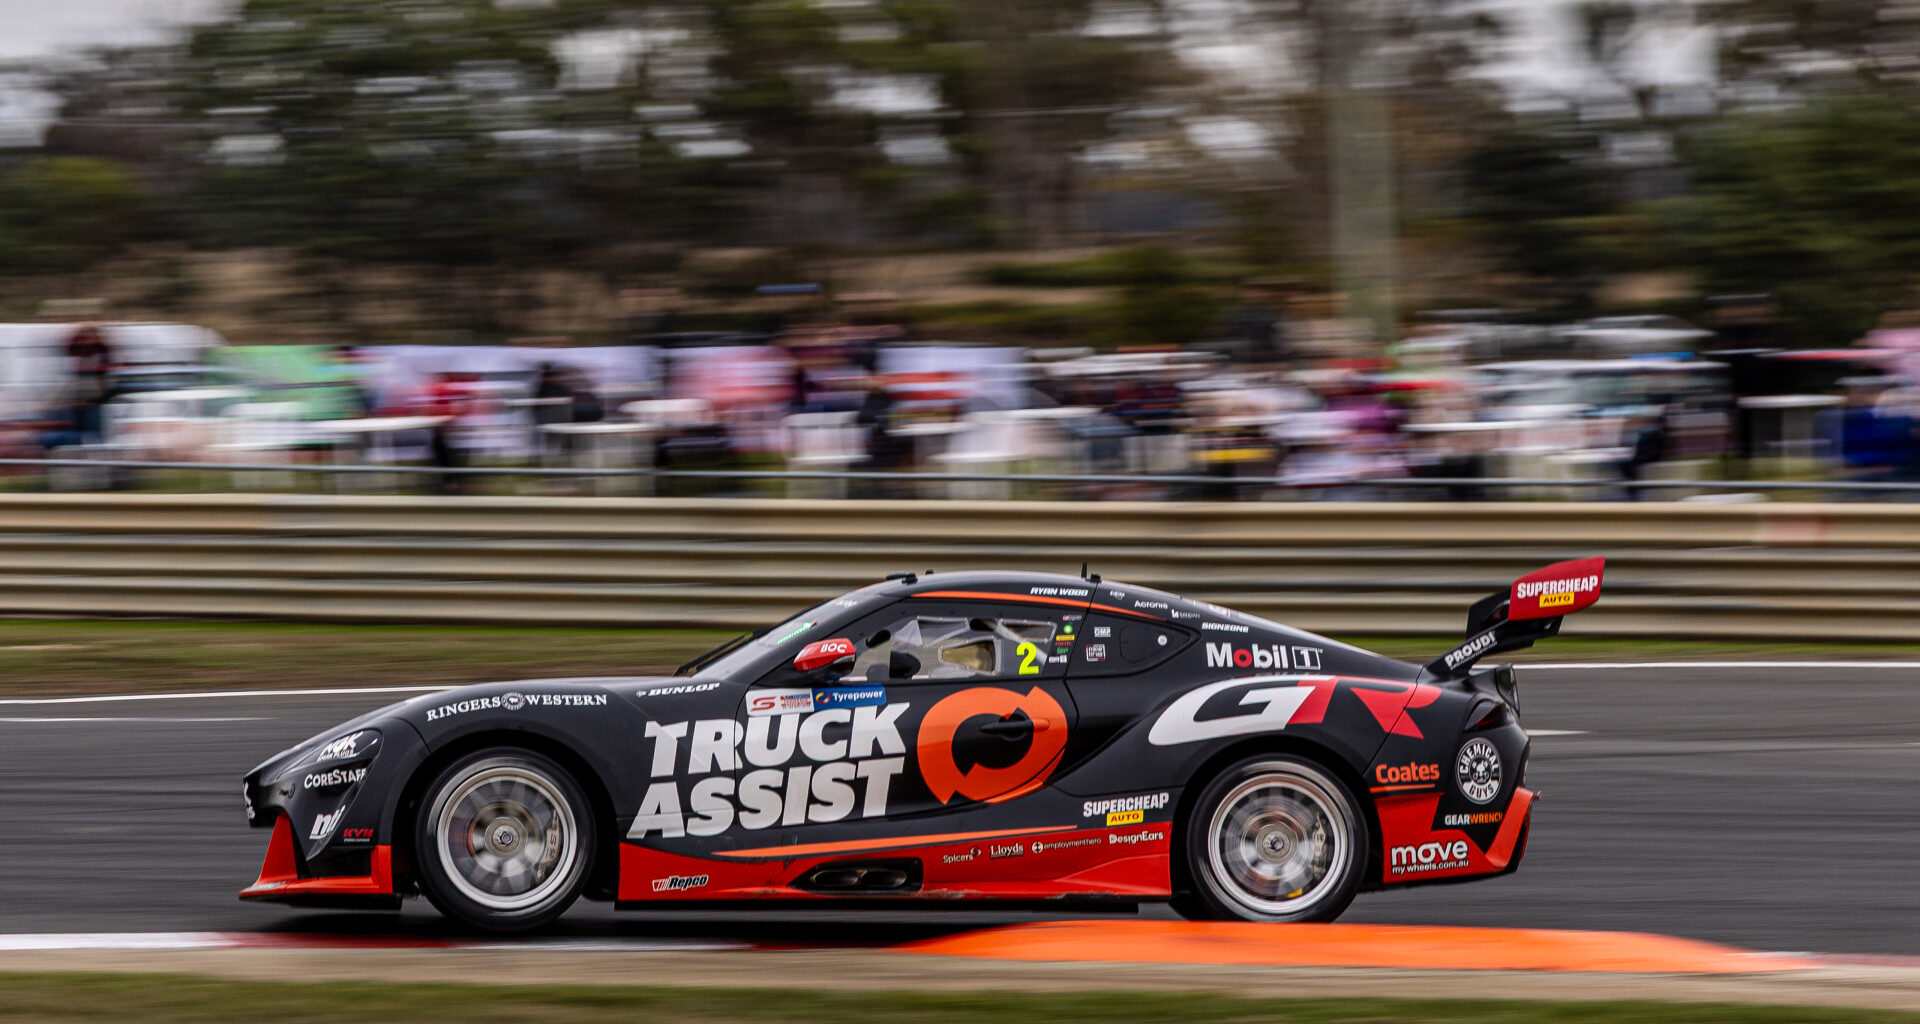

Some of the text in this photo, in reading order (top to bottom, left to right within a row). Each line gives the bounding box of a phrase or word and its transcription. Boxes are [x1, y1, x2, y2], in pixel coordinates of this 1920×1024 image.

[1030, 587, 1088, 596] RYAN WOOD
[1517, 575, 1599, 599] SUPERCHEAP
[820, 643, 847, 653] BOC
[1016, 642, 1039, 675] 2
[1206, 642, 1289, 668] Mobil
[648, 683, 720, 697] DUNLOP
[832, 690, 883, 702] Tyrepower
[426, 696, 501, 721] RINGERS
[525, 694, 607, 706] WESTERN
[1148, 676, 1442, 744] GR
[643, 702, 910, 777] TRUCK
[1459, 743, 1499, 774] CHEMICAL
[1375, 762, 1440, 783] Coates
[626, 757, 906, 838] ASSIST
[1468, 784, 1495, 798] GUYS
[1083, 792, 1169, 817] SUPERCHEAP
[1110, 812, 1140, 823] AUTO
[942, 854, 974, 864] Spicers
[990, 843, 1024, 857] Lloyds
[1391, 840, 1468, 866] move
[1392, 860, 1469, 874] my wheels.com.au
[668, 875, 709, 891] Repco
